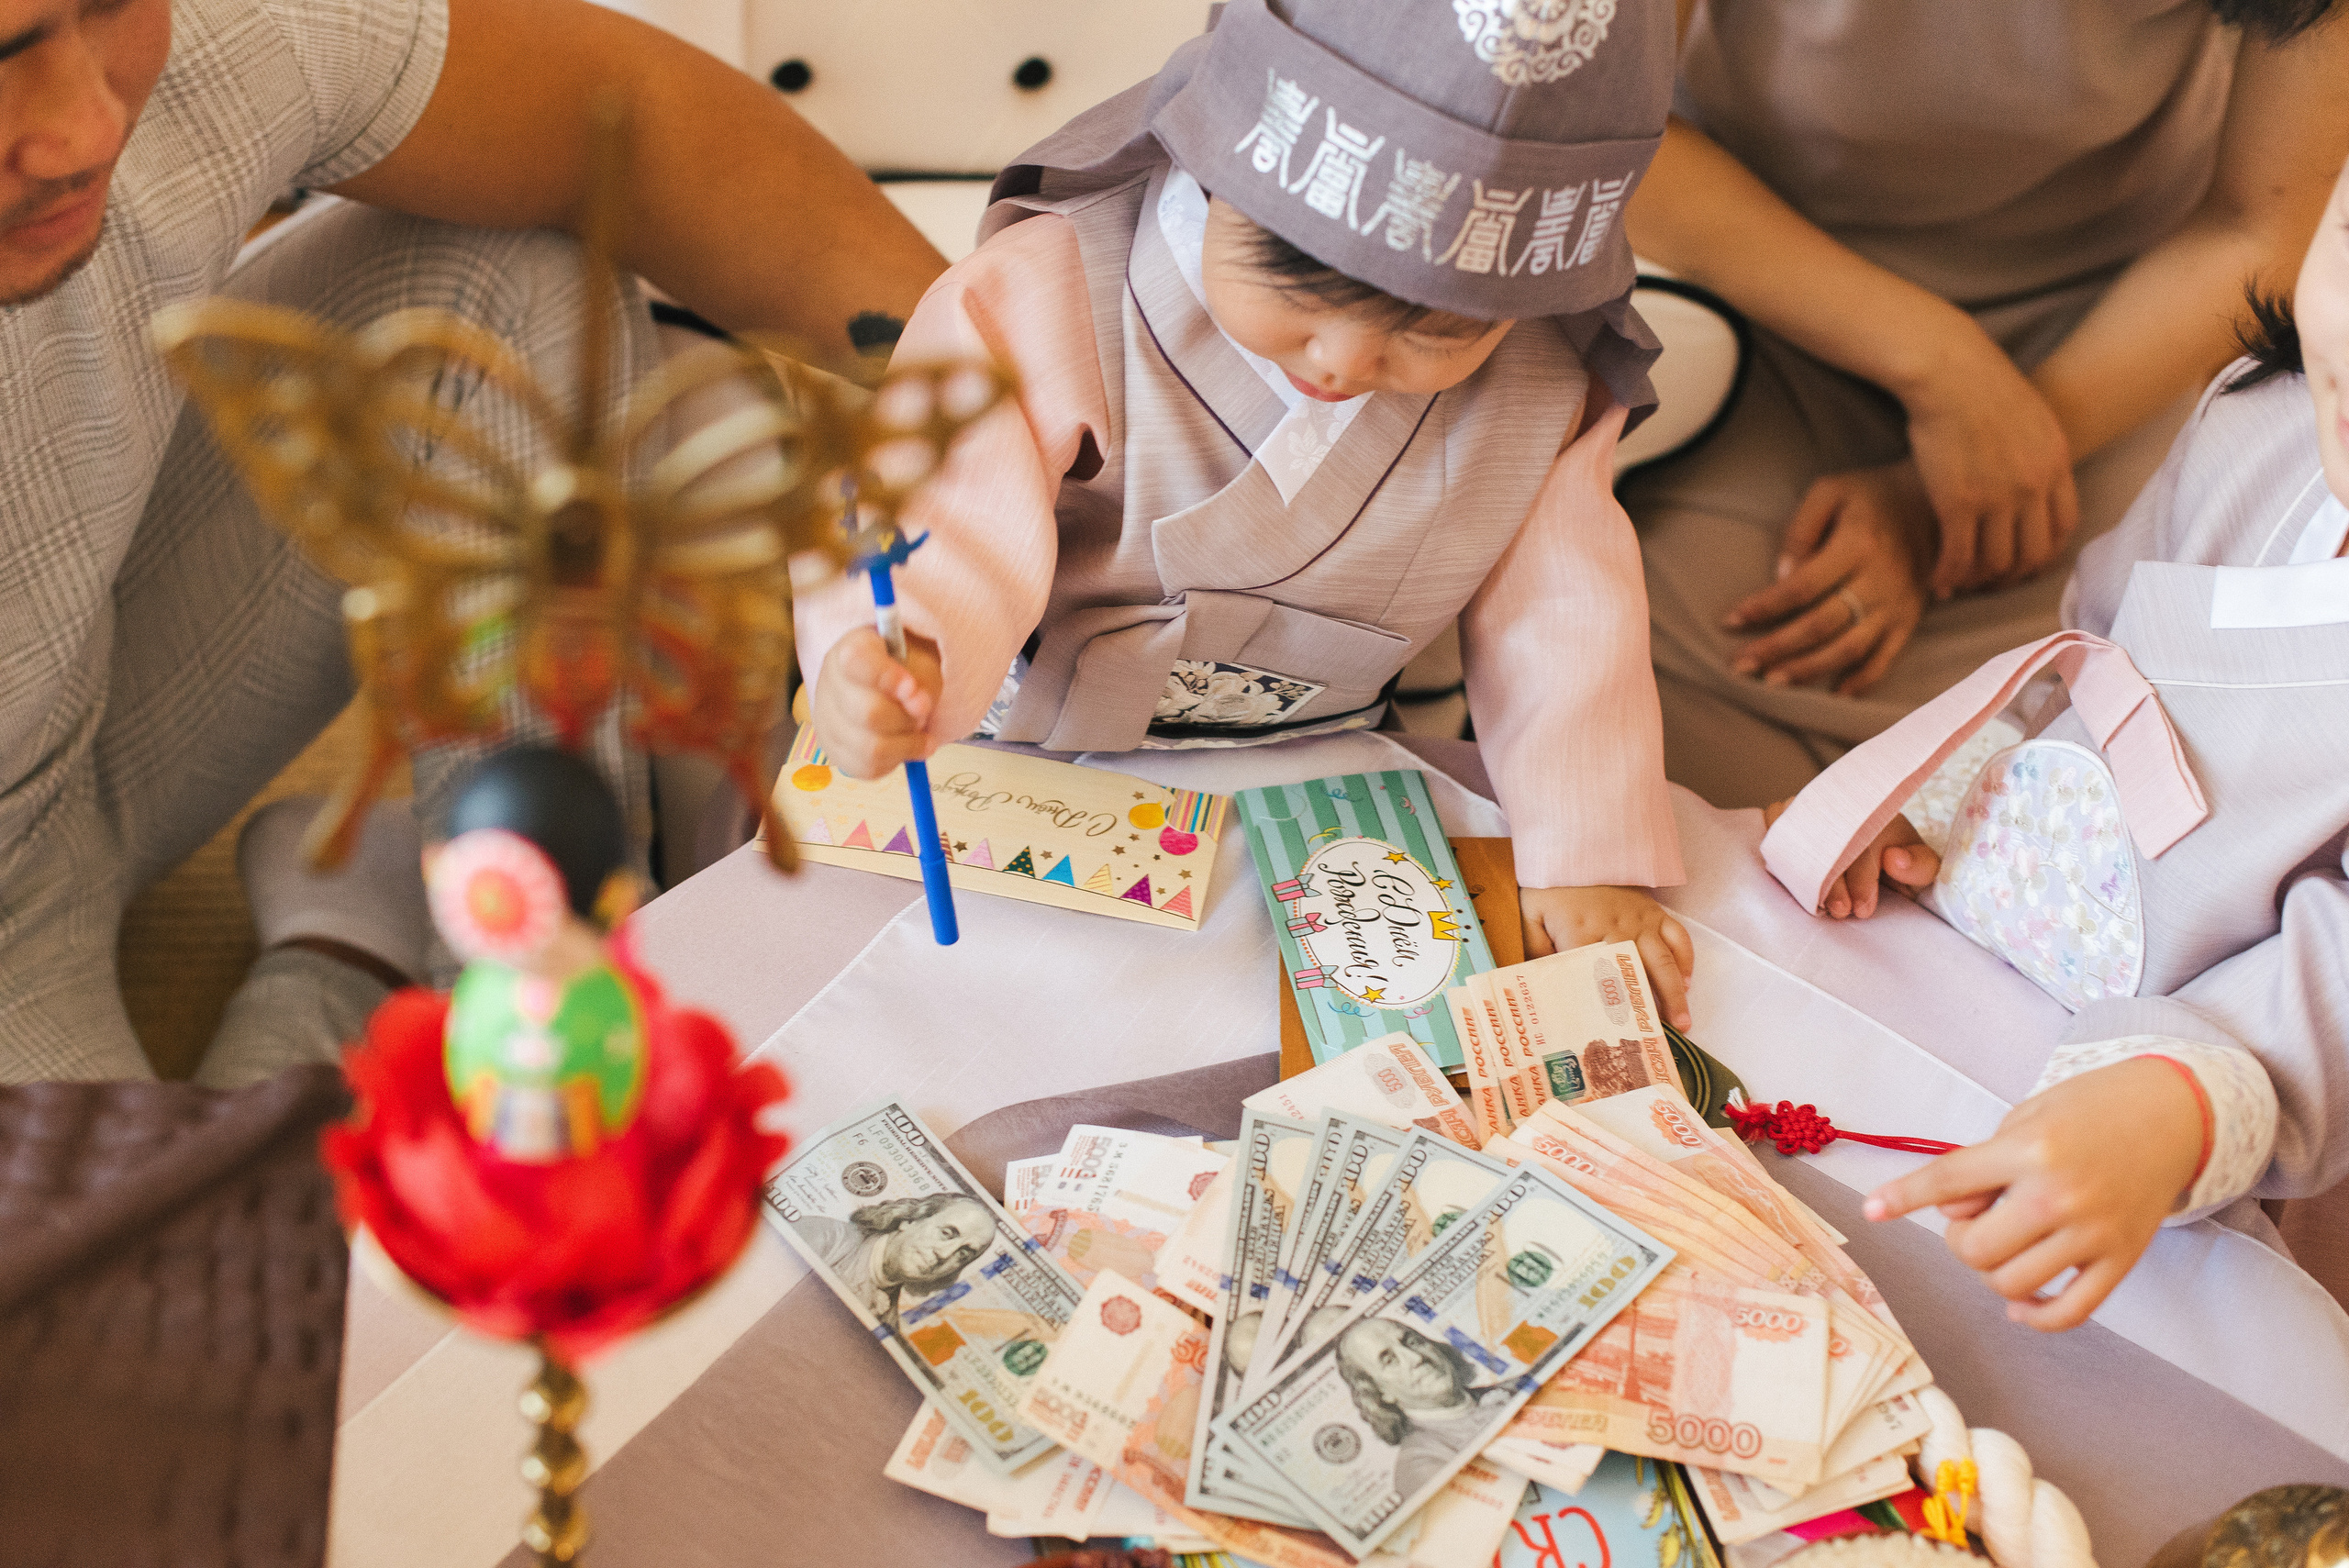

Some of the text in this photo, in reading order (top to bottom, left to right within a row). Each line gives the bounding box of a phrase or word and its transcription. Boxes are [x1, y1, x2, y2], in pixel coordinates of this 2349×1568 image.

[1086, 812, 1118, 837] С
[1318, 861, 1389, 983] Рождения!
[1373, 869, 1424, 967] С Днём
[1601, 979, 1620, 1006] 5000
[1486, 1007, 1531, 1118] АНКА РОССИИ
[1506, 997, 1547, 1106] АНКА РОССИИ
[1377, 1069, 1403, 1093] 5000
[1463, 1016, 1499, 1138] АНКА РОССИИ
[885, 1110, 925, 1146] 100
[1655, 1104, 1702, 1147] 5000
[1341, 1145, 1368, 1191] 100
[1394, 1150, 1427, 1192] 100
[1535, 1139, 1595, 1173] 5000
[1483, 1184, 1526, 1224] 100
[1577, 1256, 1637, 1310] 100
[1735, 1307, 1800, 1331] 5000
[957, 1388, 1013, 1443] 100
[1646, 1405, 1763, 1460] 5000
